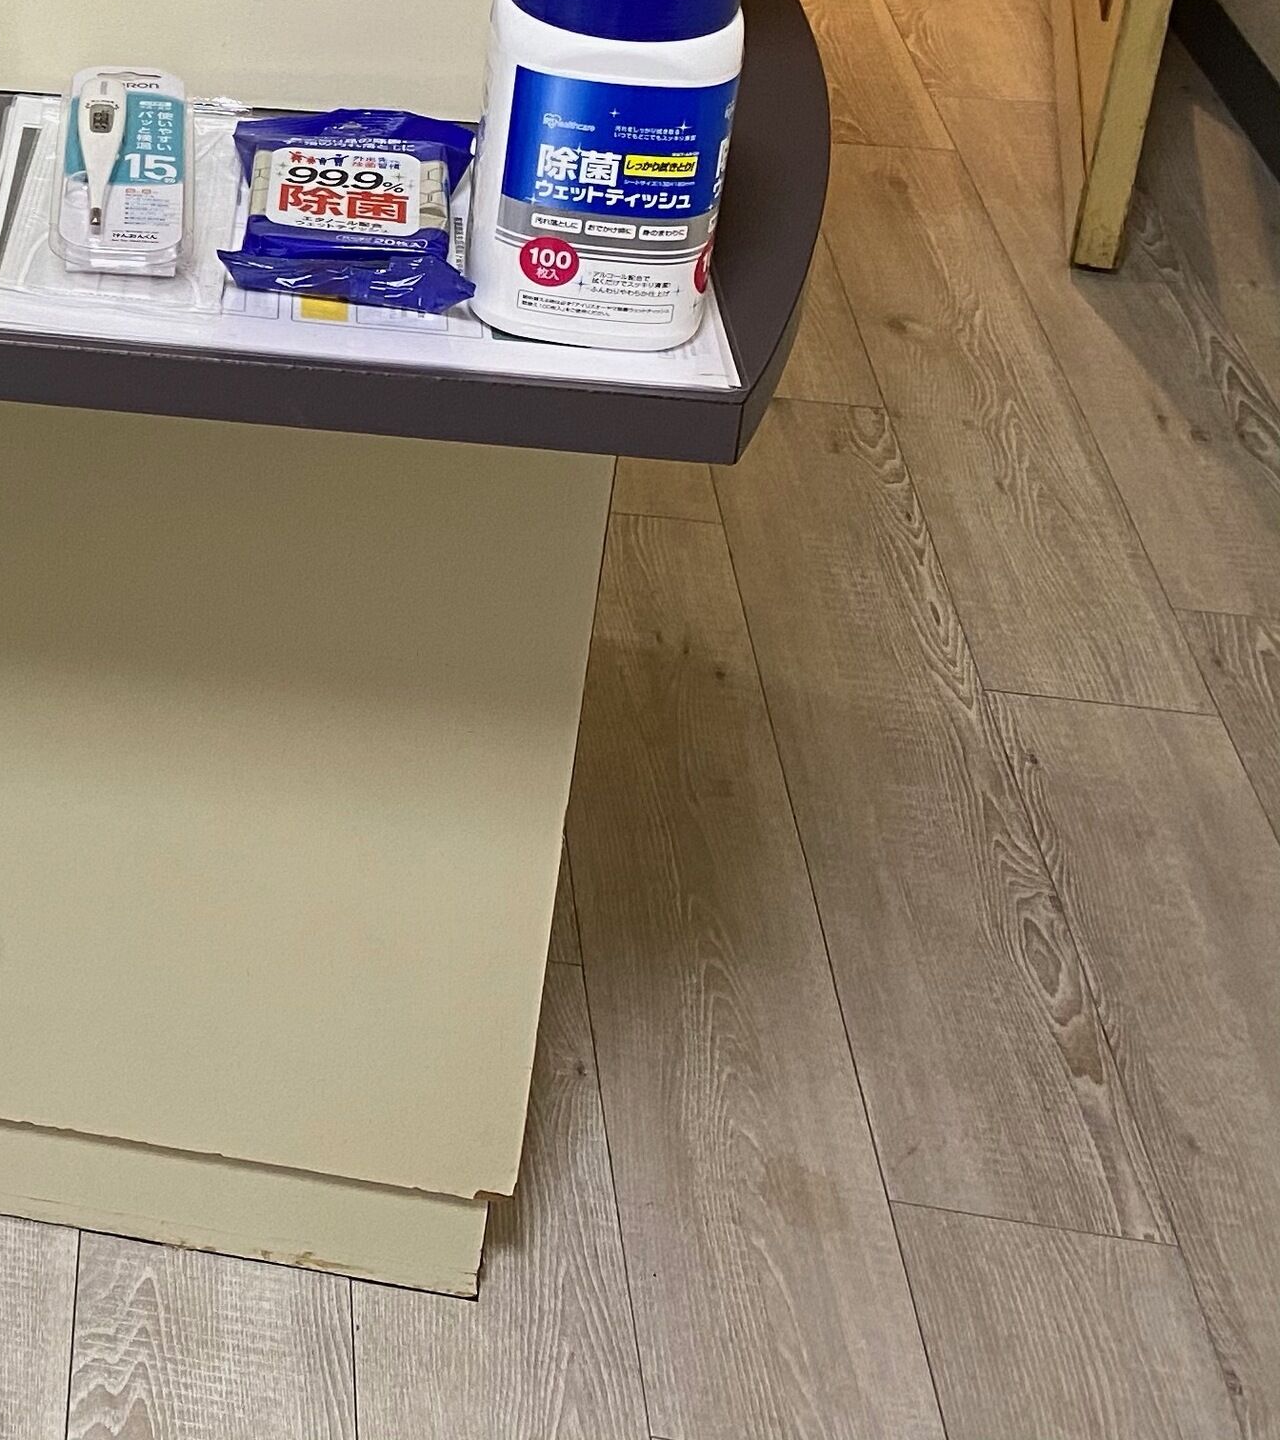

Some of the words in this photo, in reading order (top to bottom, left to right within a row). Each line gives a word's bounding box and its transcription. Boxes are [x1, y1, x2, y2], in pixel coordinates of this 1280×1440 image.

[157, 112, 174, 151] 使いやすい
[125, 153, 177, 180] 15
[536, 143, 622, 188] 除菌
[285, 166, 404, 193] 99.9%
[278, 183, 409, 224] 除菌
[535, 179, 691, 209] ウェットティッシュ
[535, 216, 579, 229] 汚れ落としに
[587, 224, 632, 235] おでかけ時に
[642, 229, 685, 237] 身のまわりに
[529, 247, 572, 270] 100
[535, 267, 560, 281] 枚入
